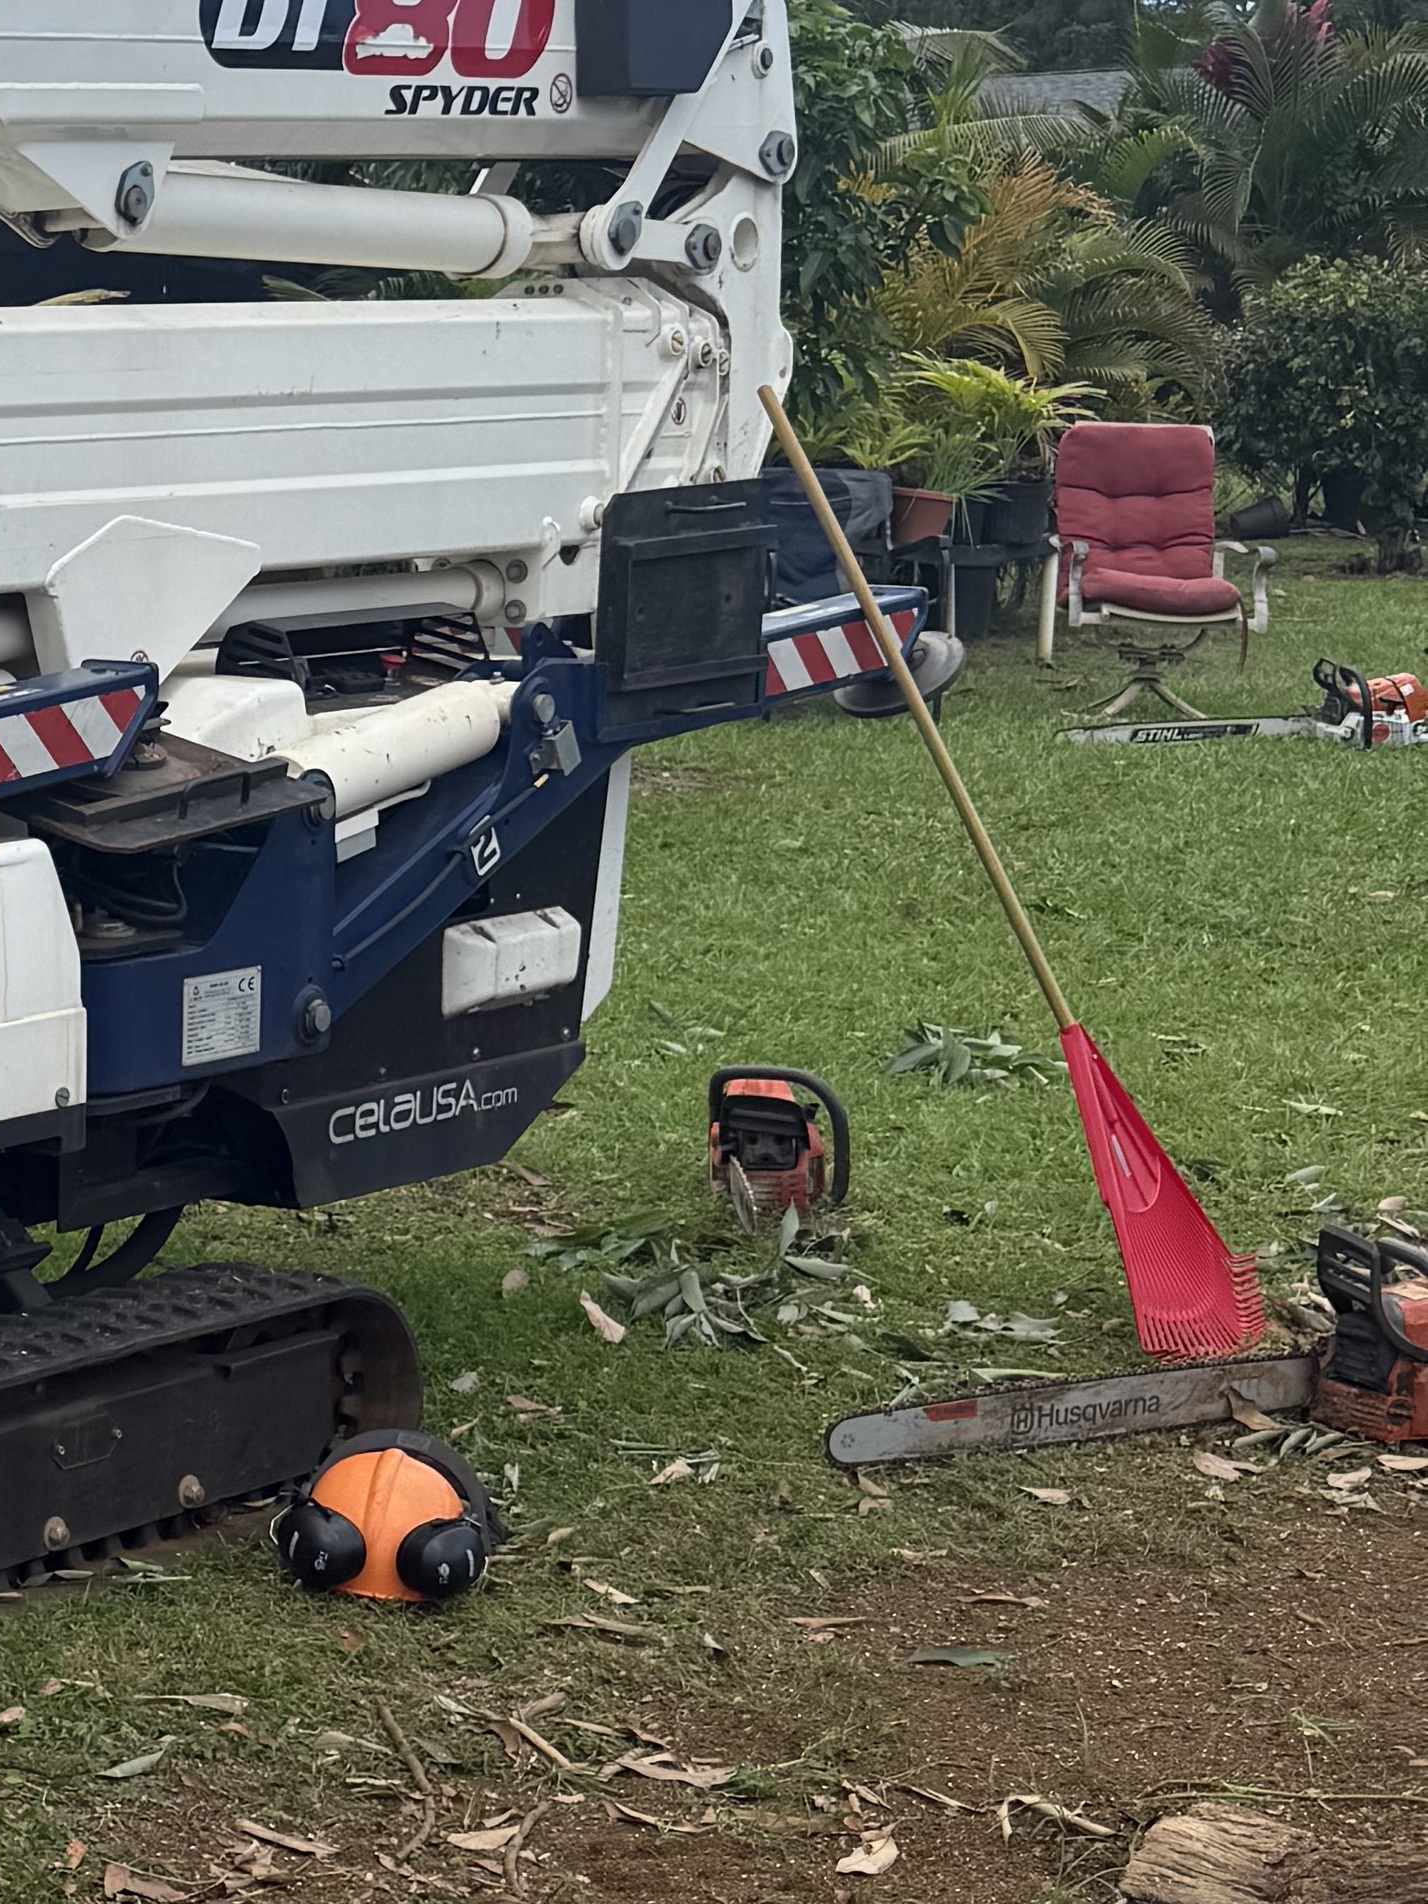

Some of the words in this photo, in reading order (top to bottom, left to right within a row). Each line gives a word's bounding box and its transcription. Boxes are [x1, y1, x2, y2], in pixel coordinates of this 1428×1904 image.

[384, 85, 540, 117] SPYDER
[1136, 728, 1182, 742] STIHL
[238, 976, 255, 993] CE
[1037, 1395, 1160, 1429] Husqvarna
